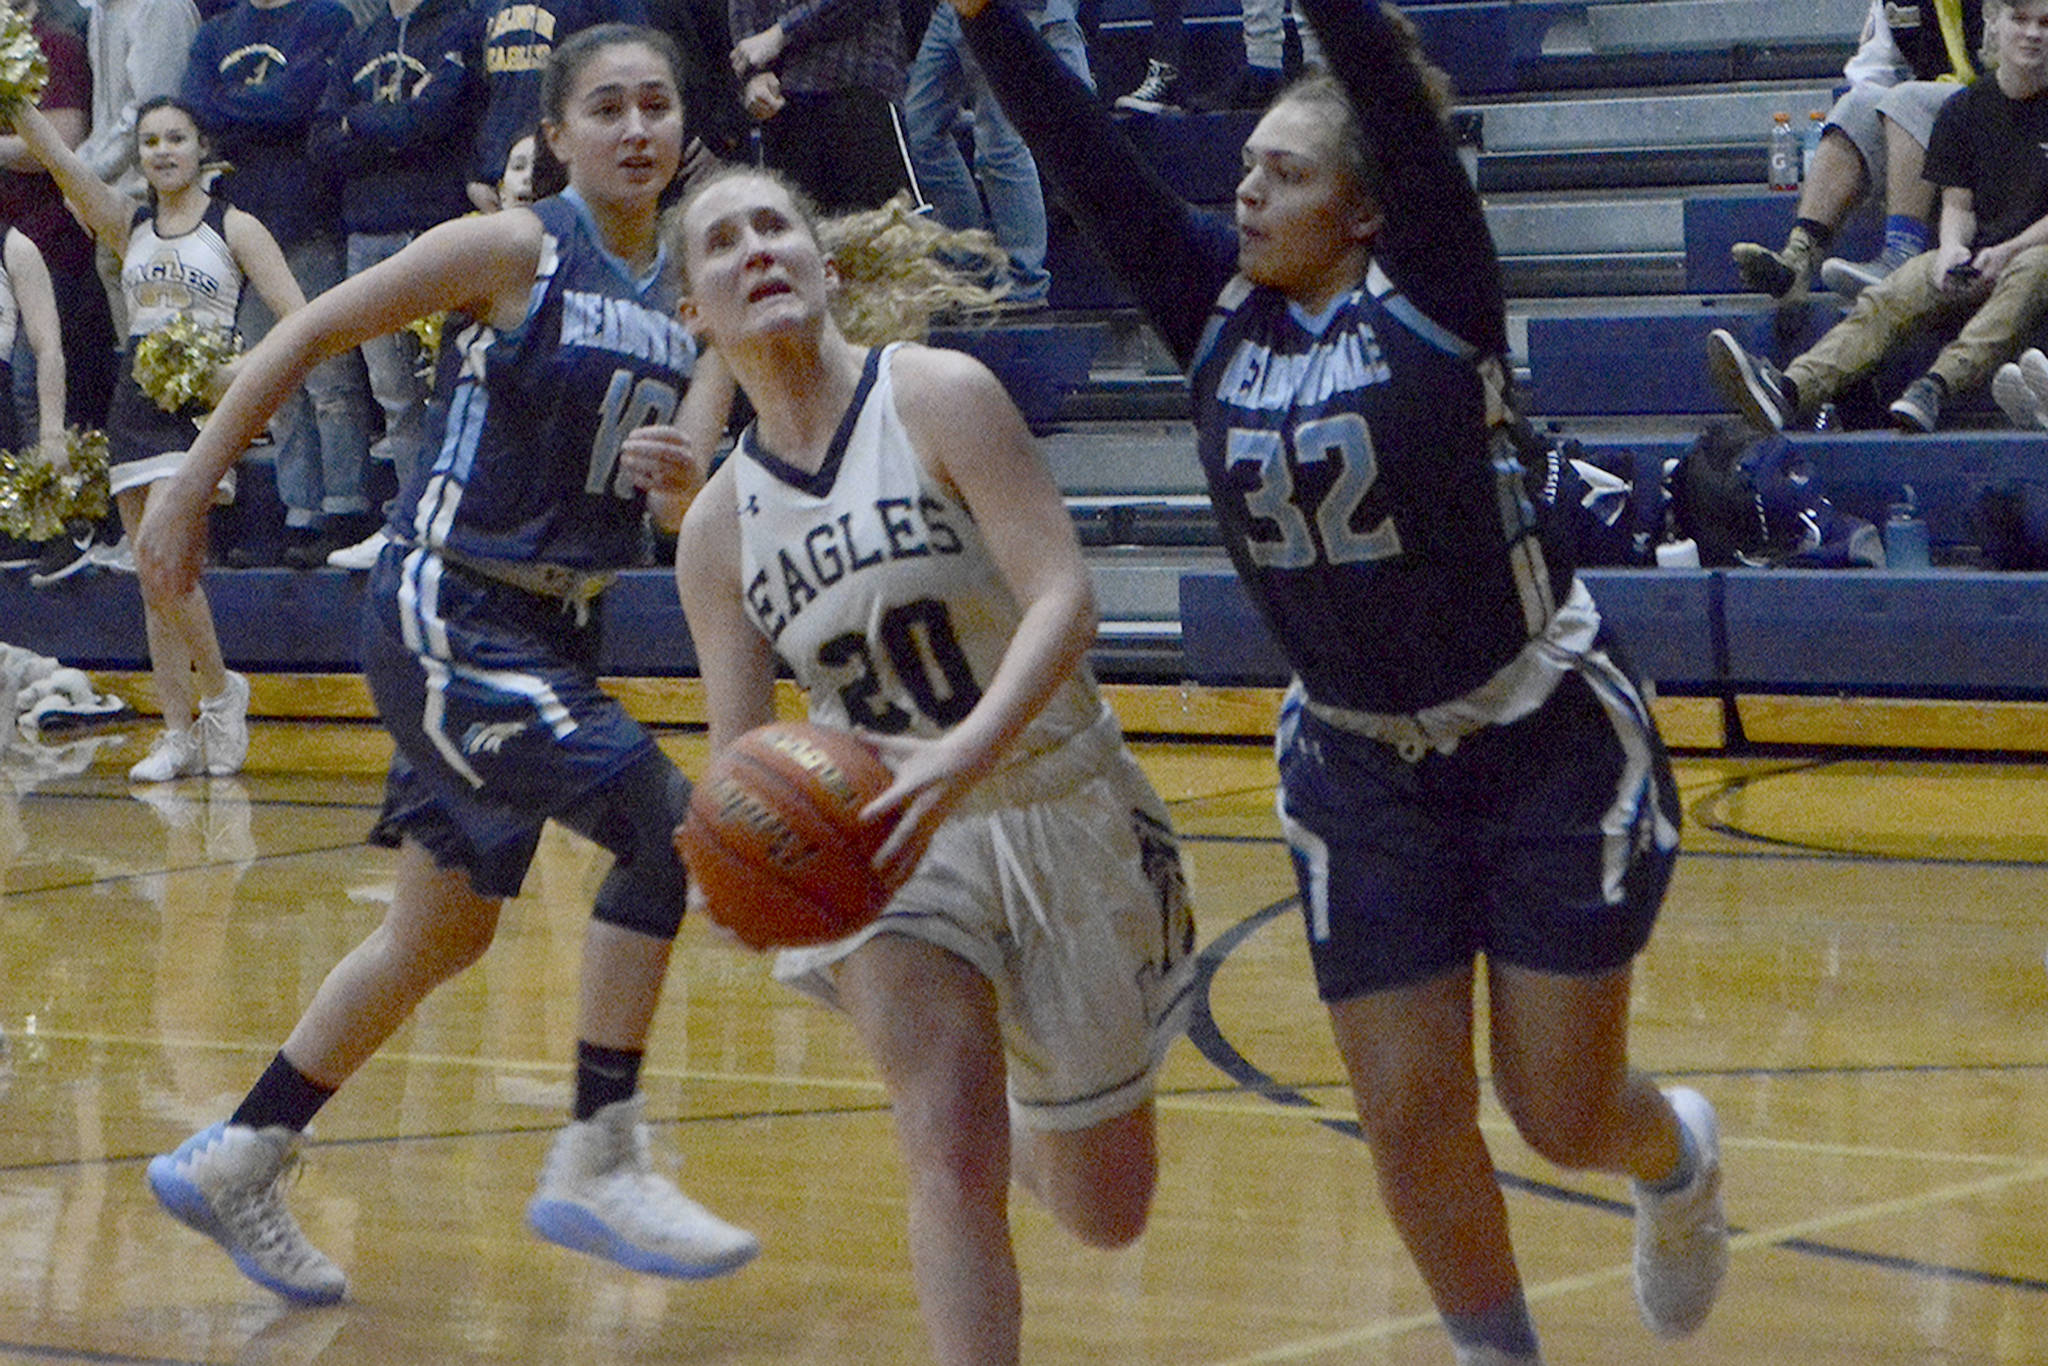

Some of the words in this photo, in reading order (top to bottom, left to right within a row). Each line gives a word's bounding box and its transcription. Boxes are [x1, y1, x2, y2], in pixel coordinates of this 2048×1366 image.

[1772, 153, 1787, 170] G
[1225, 411, 1404, 569] 32
[746, 496, 965, 644] EAGLES
[816, 596, 985, 735] 20
